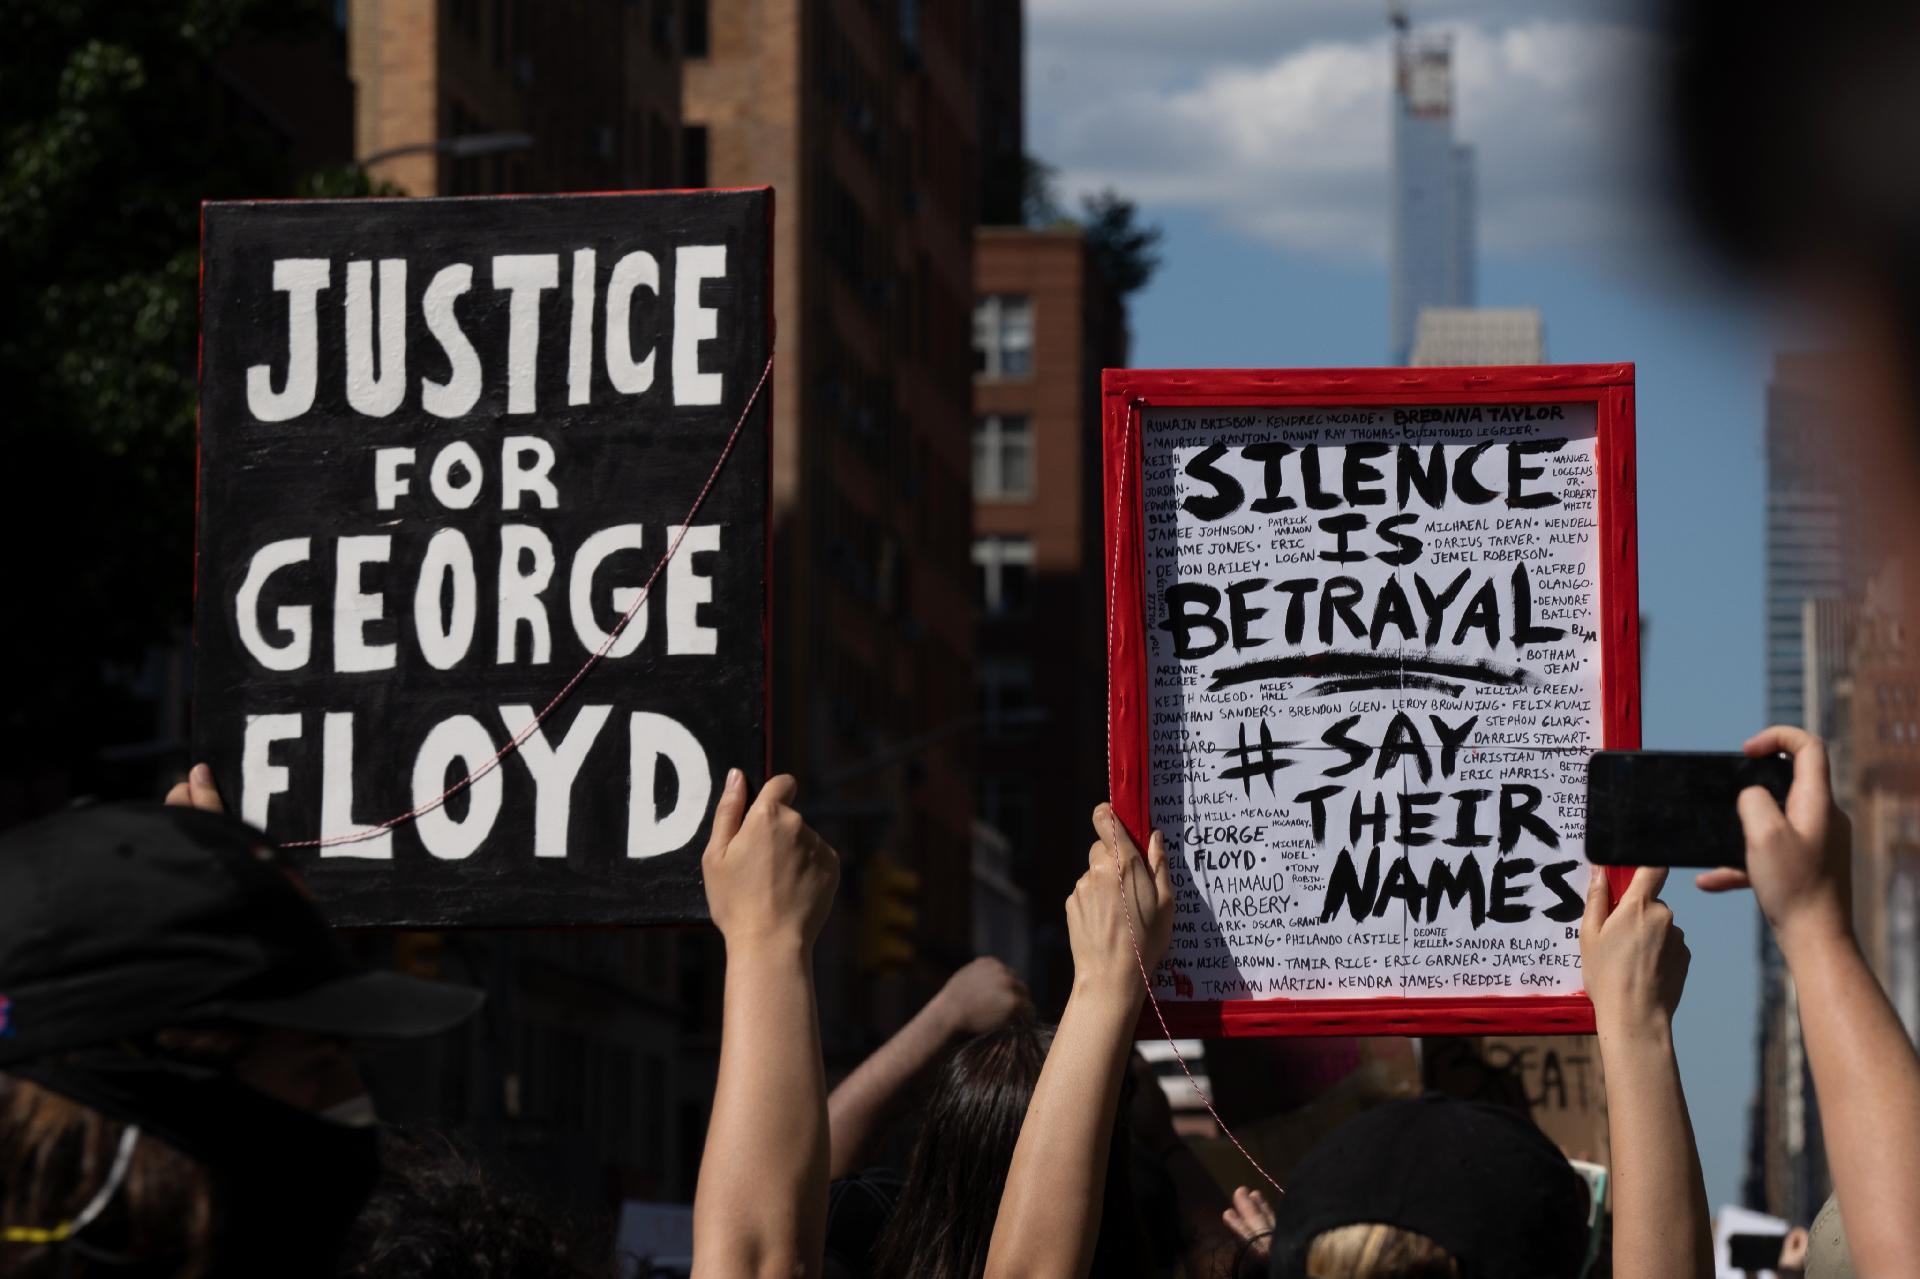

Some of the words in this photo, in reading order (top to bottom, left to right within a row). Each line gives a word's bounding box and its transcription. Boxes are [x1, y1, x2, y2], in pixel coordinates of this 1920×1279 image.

[247, 245, 727, 422] JUSTICE
[1488, 406, 1564, 422] TAYLOR
[1153, 437, 1206, 449] MAURICE
[1213, 432, 1270, 445] GRANTON
[1283, 429, 1319, 440] DANNY
[1325, 429, 1345, 439] RAY
[1350, 428, 1394, 439] THOMAS
[1145, 454, 1180, 466] KEITH
[375, 435, 559, 510] FOR
[1145, 468, 1179, 480] SCOTT
[1183, 438, 1568, 521] SILENCE
[1146, 483, 1184, 497] JORDAN
[1564, 489, 1597, 498] ROBERT
[1564, 502, 1592, 511] WHITE
[1268, 516, 1307, 527] PATRICK
[1497, 517, 1532, 530] DEAN
[1545, 518, 1597, 528] WENDELL
[1148, 527, 1192, 541] JAMEE
[1198, 525, 1254, 537] JOHNSON
[1275, 525, 1312, 535] HARMON
[1271, 539, 1305, 549] ERIC
[1317, 512, 1423, 566] IS
[1435, 536, 1482, 549] DARIUS
[1488, 534, 1534, 546] TARVER
[1549, 533, 1588, 545] ALLEN
[1156, 544, 1204, 558] KWAME
[1208, 541, 1255, 555] JONES
[1276, 550, 1315, 563] LOGAN
[1431, 551, 1478, 565] JEMEL
[1484, 548, 1548, 561] ROBERSON
[1208, 560, 1260, 575] BAILEY
[1536, 563, 1585, 575] ALFRED
[1539, 579, 1589, 590] OLANGO
[236, 523, 720, 673] GEORGE
[1539, 594, 1591, 605] DEANDRE
[1158, 561, 1568, 659] BETRAYAL
[1542, 608, 1587, 620] BAILEY
[1572, 624, 1597, 642] BLM
[1527, 650, 1575, 660] BOTHAM
[1157, 665, 1198, 675] ARIANE
[1543, 661, 1580, 674] JEAN
[1260, 682, 1293, 692] MILES
[1475, 685, 1528, 695] WILLIAM
[1533, 685, 1578, 695] GREEN
[1155, 693, 1194, 707] KEITH
[1262, 692, 1288, 700] HALL
[1153, 710, 1213, 725] JONATHAN
[1220, 705, 1276, 719] SANDERS
[1350, 701, 1380, 712] GLEN
[1392, 700, 1427, 711] LEROY
[1432, 700, 1499, 711] BROWNING
[1513, 700, 1551, 710] FELIX
[1554, 700, 1591, 711] KUMI
[1486, 716, 1536, 726] STEPHON
[1153, 729, 1189, 741] DAVID
[1474, 732, 1529, 744] DARRIUS
[1533, 732, 1587, 745] STEWART
[1154, 741, 1215, 755] MALLARD
[1320, 709, 1479, 785] SAY
[1463, 752, 1534, 764] CHRISTIAN
[1541, 746, 1590, 760] TAYLOR
[1154, 759, 1206, 770] MIGUEL
[1560, 761, 1588, 772] BETTI
[1153, 771, 1210, 785] ESPINAL
[1461, 769, 1493, 781] ERIC
[1500, 768, 1549, 780] HARRIS
[1560, 774, 1587, 784] JONE
[242, 704, 712, 860] FLOYD
[1154, 795, 1183, 806] AKAI
[1189, 791, 1232, 804] GURLEY
[1156, 813, 1201, 824] ANTHONY
[1205, 812, 1231, 822] HILL
[1241, 808, 1290, 818] MEAGAN
[1293, 783, 1561, 855] THEIR
[1184, 825, 1268, 845] GEORGE
[1272, 840, 1315, 850] MICHEAL
[1194, 850, 1256, 872] FLOYD
[1281, 851, 1309, 860] NOEL
[1290, 863, 1319, 873] TONY
[1214, 873, 1283, 894] AHMAUD
[1321, 846, 1586, 930] NAMES
[1219, 895, 1291, 917] ARBERY
[1172, 923, 1196, 932] MAR
[1201, 922, 1242, 932] CLARK
[1253, 919, 1285, 929] OSCAR
[1289, 916, 1321, 927] GRANT
[1204, 933, 1275, 948] STERLING
[1285, 934, 1342, 946] PHILANDO
[1347, 933, 1400, 945] CASTILE
[1414, 939, 1448, 948] KELLER
[1456, 938, 1505, 950] SANDRA
[1510, 938, 1550, 950] BLAND
[1158, 958, 1187, 969] SEAN
[1197, 957, 1229, 969] MIKE
[1235, 957, 1275, 968] BROWN
[1285, 958, 1330, 970] TAMIR
[1335, 958, 1371, 969] RICE
[1385, 955, 1421, 968] ERIC
[1426, 954, 1480, 967] GARNER
[1493, 954, 1536, 967] JAMES
[1202, 980, 1262, 994] TRAYVON
[1269, 978, 1326, 992] MARTIN
[1339, 975, 1392, 989] KENDRA
[1400, 975, 1443, 988] JAMES
[1454, 974, 1512, 986] FREDDIE
[1520, 973, 1553, 986] GRAY
